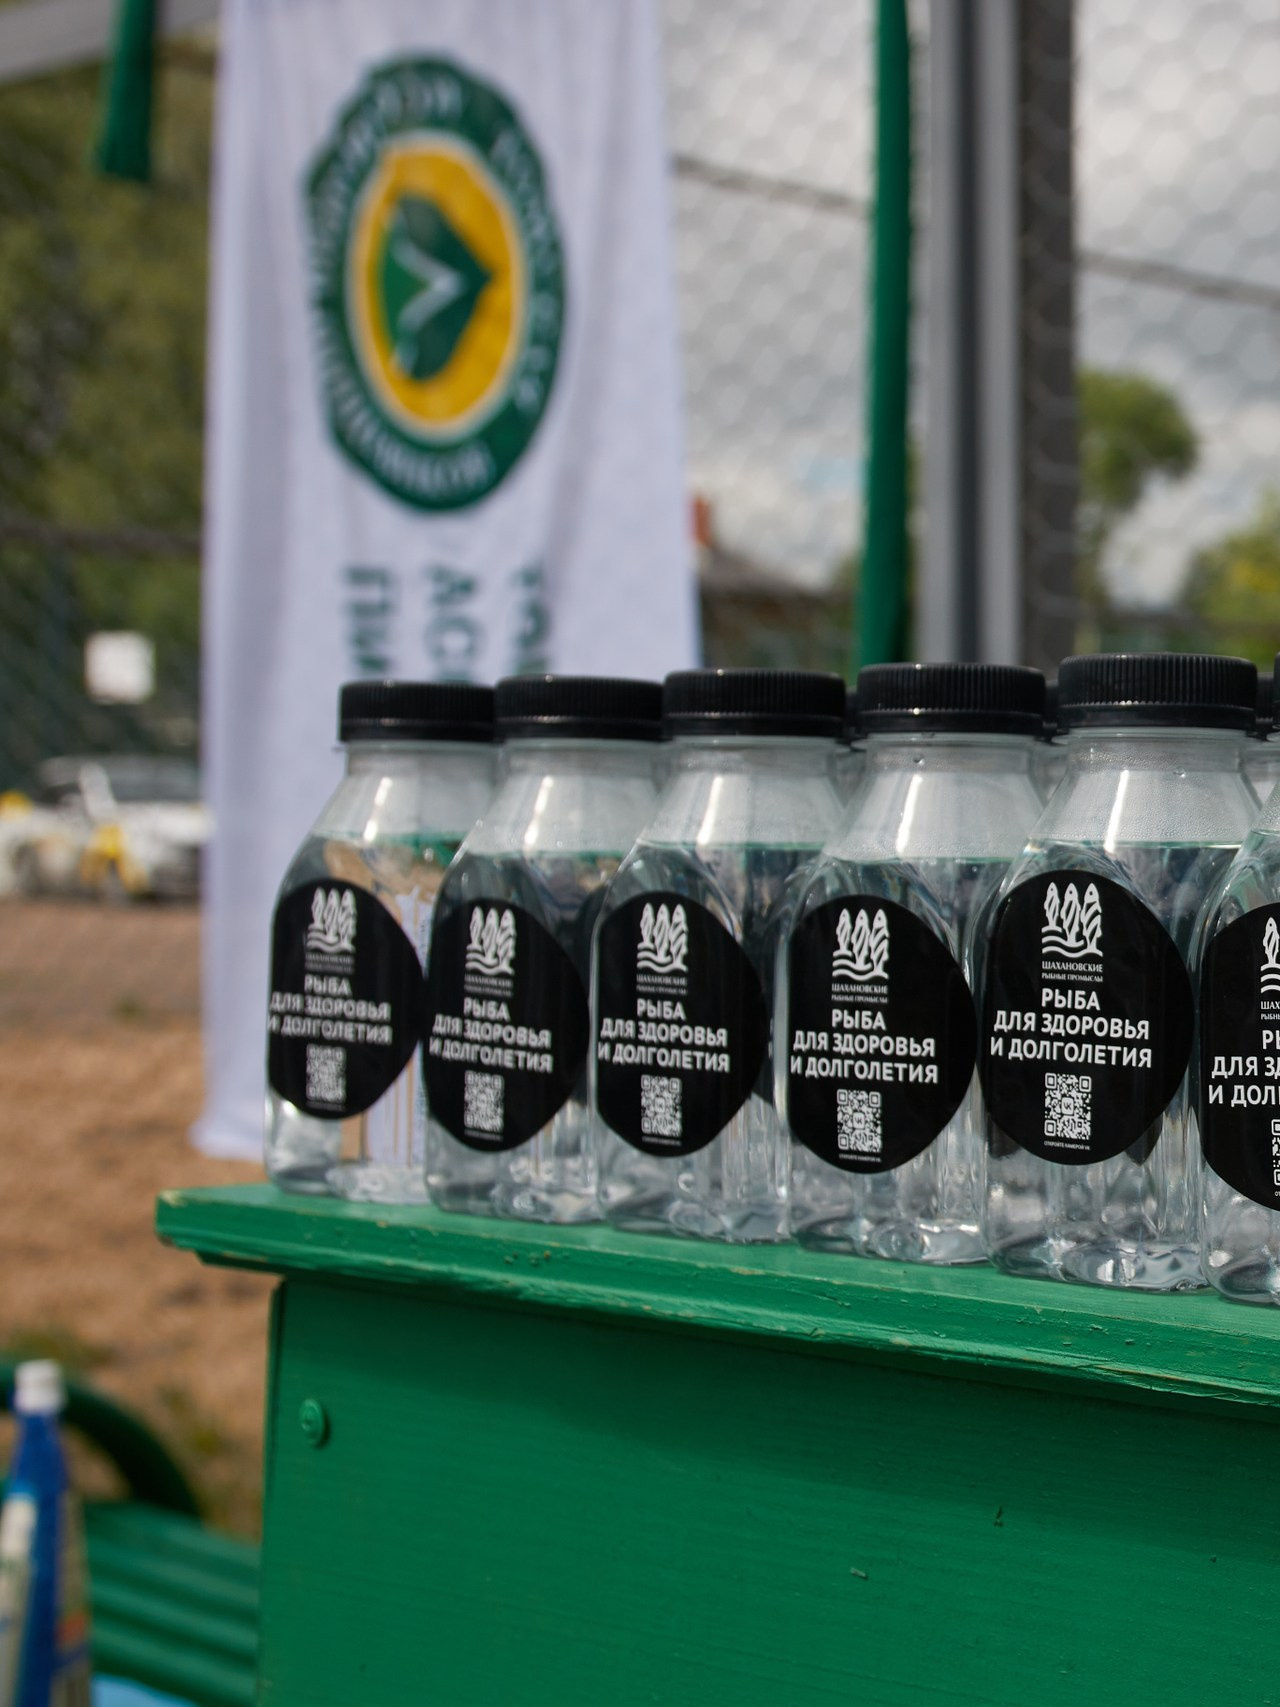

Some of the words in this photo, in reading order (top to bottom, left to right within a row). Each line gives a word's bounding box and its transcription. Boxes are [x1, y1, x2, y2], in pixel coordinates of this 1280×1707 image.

[1042, 961, 1103, 973] ШАХАНОВСКИЕ
[304, 973, 352, 996] РЫБА
[832, 983, 888, 994] ШАХАНОВСКИЕ
[270, 991, 304, 1012] ДЛЯ
[304, 995, 392, 1022] ЗДОРОВЬЯ
[463, 997, 511, 1022] РЫБА
[637, 998, 686, 1020] РЫБА
[1041, 988, 1100, 1011] РЫБА
[281, 1015, 393, 1045] ДОЛГОЛЕТИЯ
[432, 1013, 462, 1036] ДЛЯ
[463, 1019, 552, 1049] ЗДОРОВЬЯ
[600, 1017, 635, 1039] ДЛЯ
[638, 1021, 728, 1047] ЗДОРОВЬЯ
[831, 1009, 886, 1030] РЫБА
[993, 1010, 1036, 1033] ДЛЯ
[1041, 1013, 1149, 1040] ЗДОРОВЬЯ
[429, 1037, 442, 1055] И
[442, 1039, 553, 1073] ДОЛГОЛЕТИЯ
[793, 1030, 828, 1052] ДЛЯ
[832, 1033, 935, 1057] ЗДОРОВЬЯ
[990, 1036, 1003, 1056] И
[1008, 1037, 1152, 1068] ДОЛГОЛЕТИЯ
[597, 1042, 611, 1060] И
[612, 1043, 730, 1073] ДОЛГОЛЕТИЯ
[790, 1055, 802, 1074] И
[805, 1057, 938, 1084] ДОЛГОЛЕТИЯ
[1211, 1056, 1258, 1079] ДЛЯ
[1208, 1084, 1224, 1104] И
